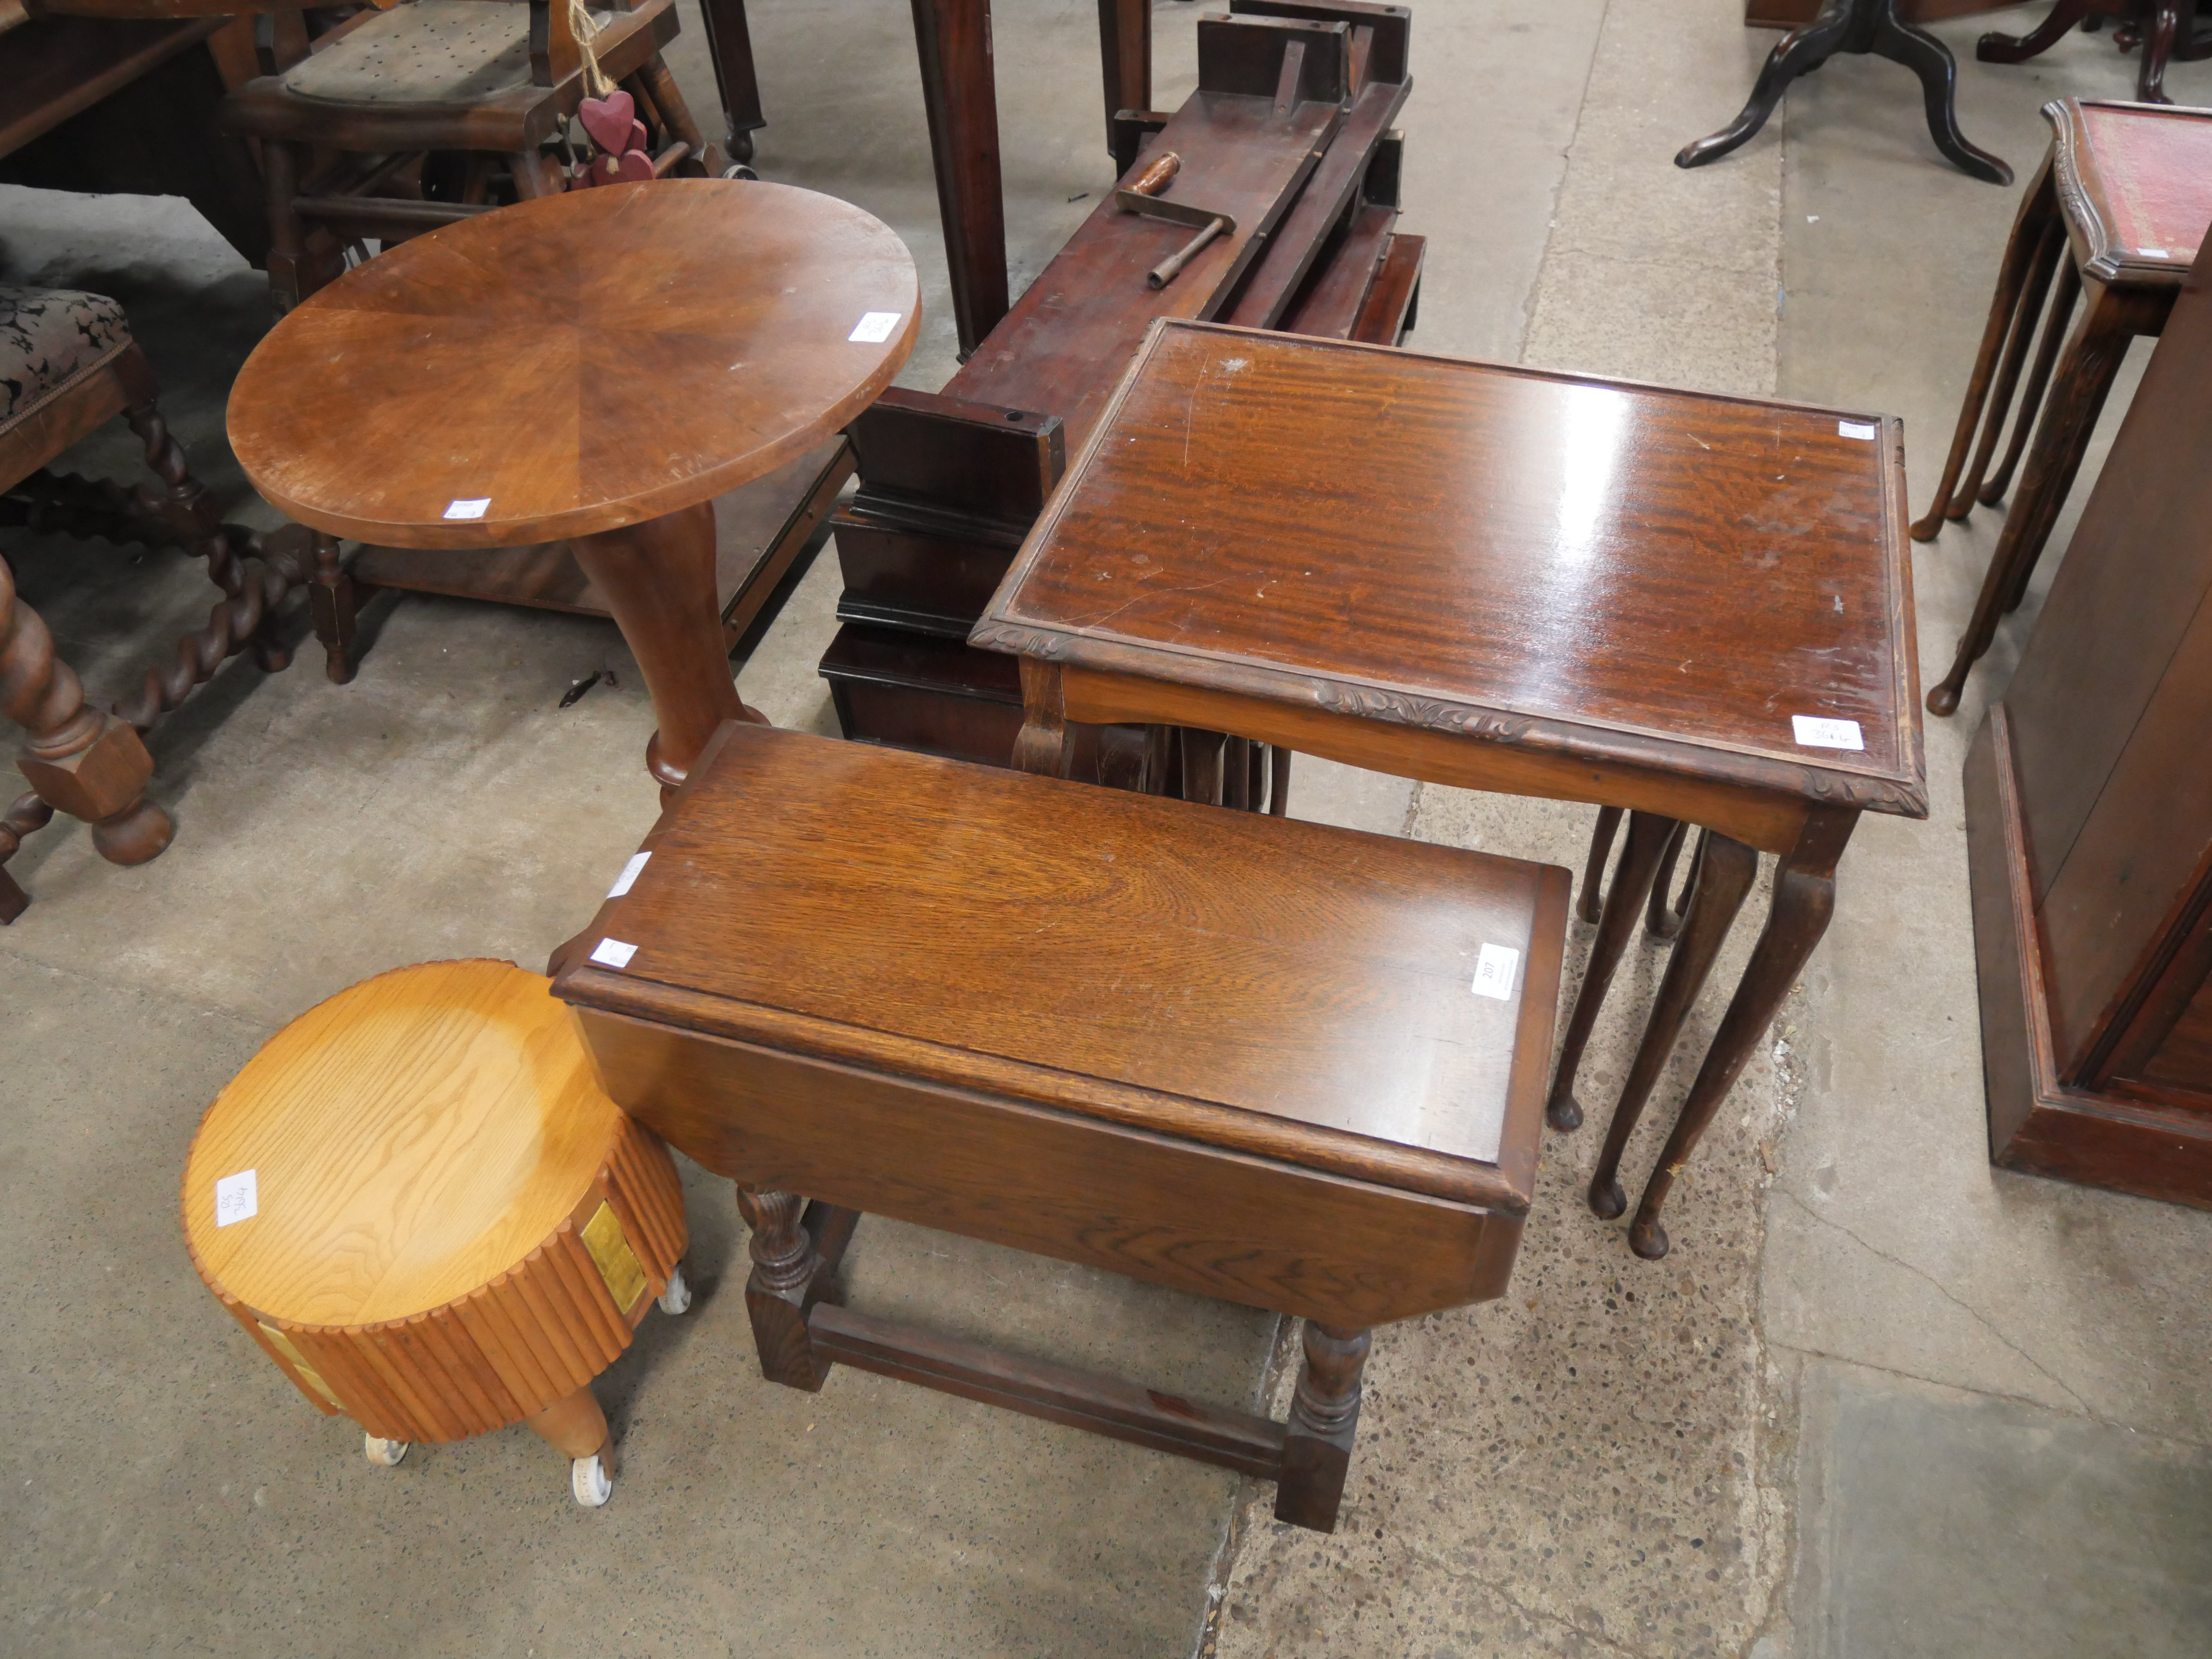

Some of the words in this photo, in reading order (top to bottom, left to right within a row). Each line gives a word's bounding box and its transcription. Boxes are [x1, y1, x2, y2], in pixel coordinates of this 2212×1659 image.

[1821, 722, 1839, 731] RS
[1482, 961, 1495, 979] 207
[221, 1194, 233, 1209] RS
[233, 1186, 248, 1216] 3614
